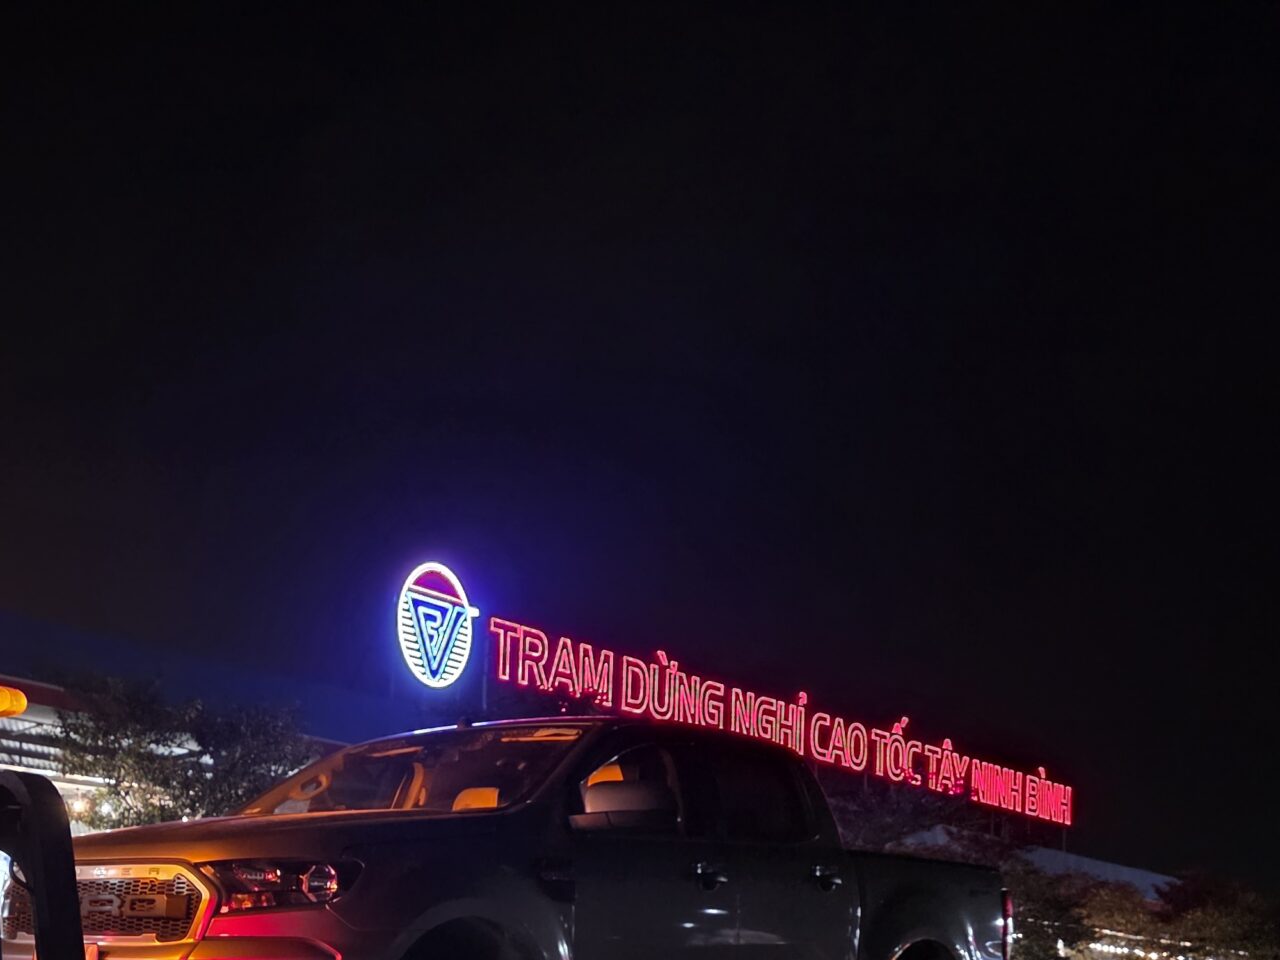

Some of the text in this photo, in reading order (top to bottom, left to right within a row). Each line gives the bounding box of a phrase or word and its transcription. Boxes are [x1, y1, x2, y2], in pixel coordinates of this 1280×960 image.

[621, 650, 724, 729] DỪNG
[730, 691, 808, 756] NGHỈ
[810, 712, 868, 771] CAO
[871, 716, 922, 785] TỐC
[924, 738, 970, 795] TÂY
[971, 758, 1023, 813] NINH
[1025, 766, 1072, 826] BÌNH
